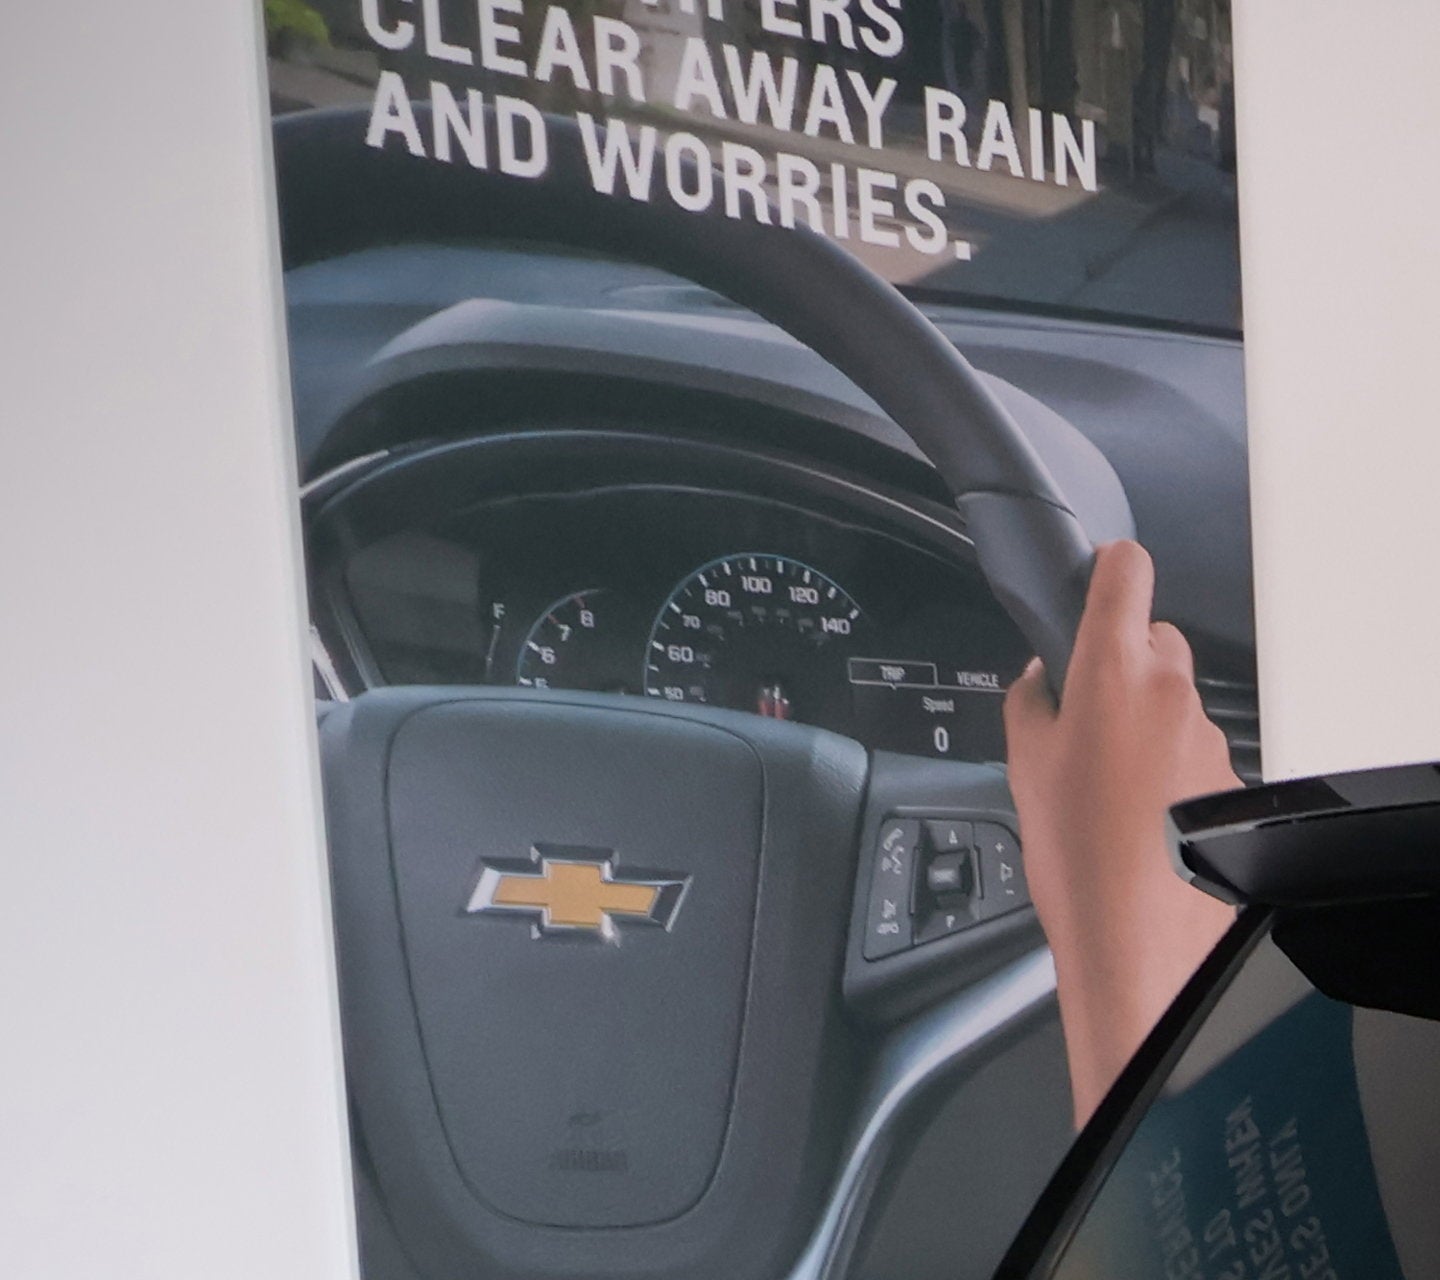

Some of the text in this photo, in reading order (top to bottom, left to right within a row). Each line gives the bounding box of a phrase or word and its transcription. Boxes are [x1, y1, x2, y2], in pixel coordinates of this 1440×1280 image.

[362, 0, 1096, 191] CLEAR AWAY RAIN
[365, 70, 971, 260] AND WORRIES.
[741, 575, 773, 594] 100
[704, 589, 731, 608] 80
[788, 586, 819, 606] 120
[682, 614, 701, 630] 70
[821, 616, 851, 635] 140
[558, 623, 572, 642] 7
[540, 646, 557, 665] 6
[667, 645, 695, 664] 60
[956, 670, 1000, 688] VEHICLE
[933, 726, 949, 752] 0
